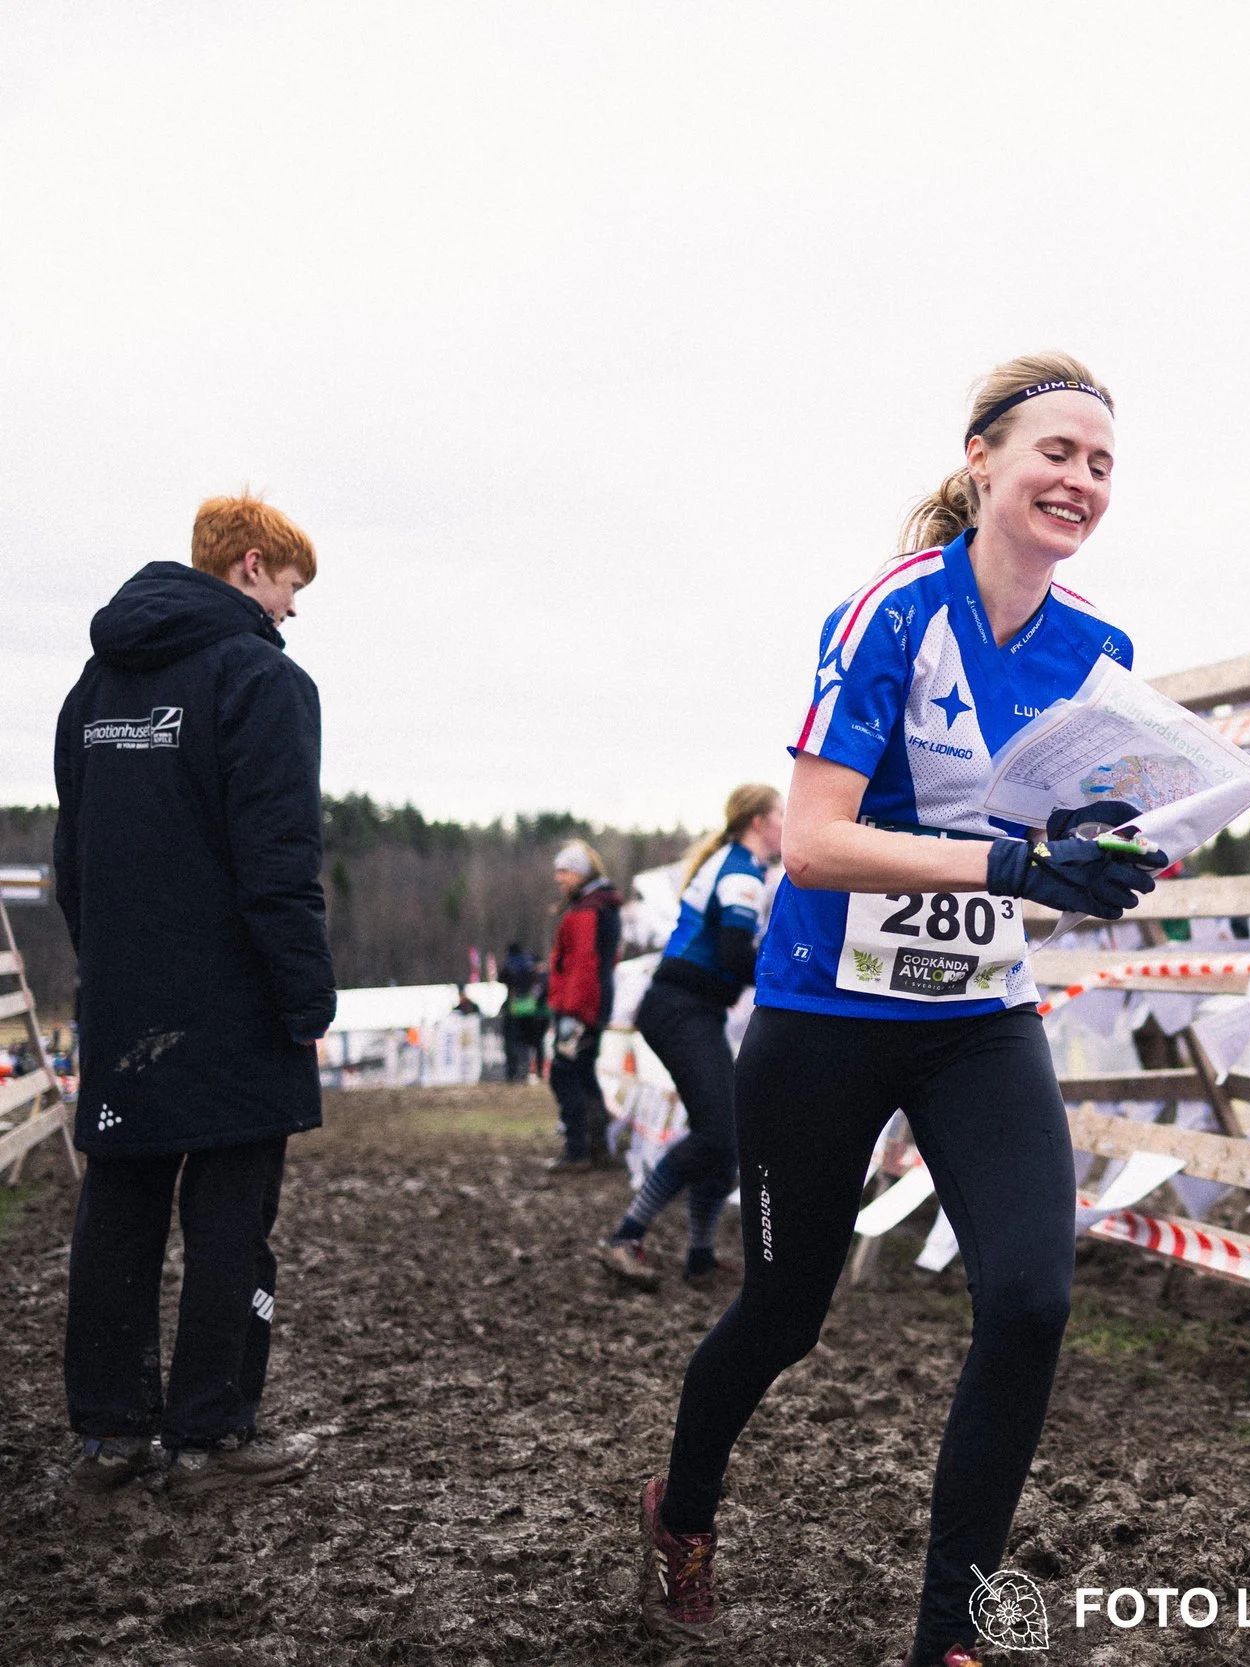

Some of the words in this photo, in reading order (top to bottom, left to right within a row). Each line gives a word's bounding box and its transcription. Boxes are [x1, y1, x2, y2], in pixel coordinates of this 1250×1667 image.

[1010, 641, 1023, 654] IFK
[908, 735, 928, 750] IFK
[880, 892, 995, 945] 280
[903, 954, 970, 972] GODKÄNDA
[252, 1288, 274, 1324] PU
